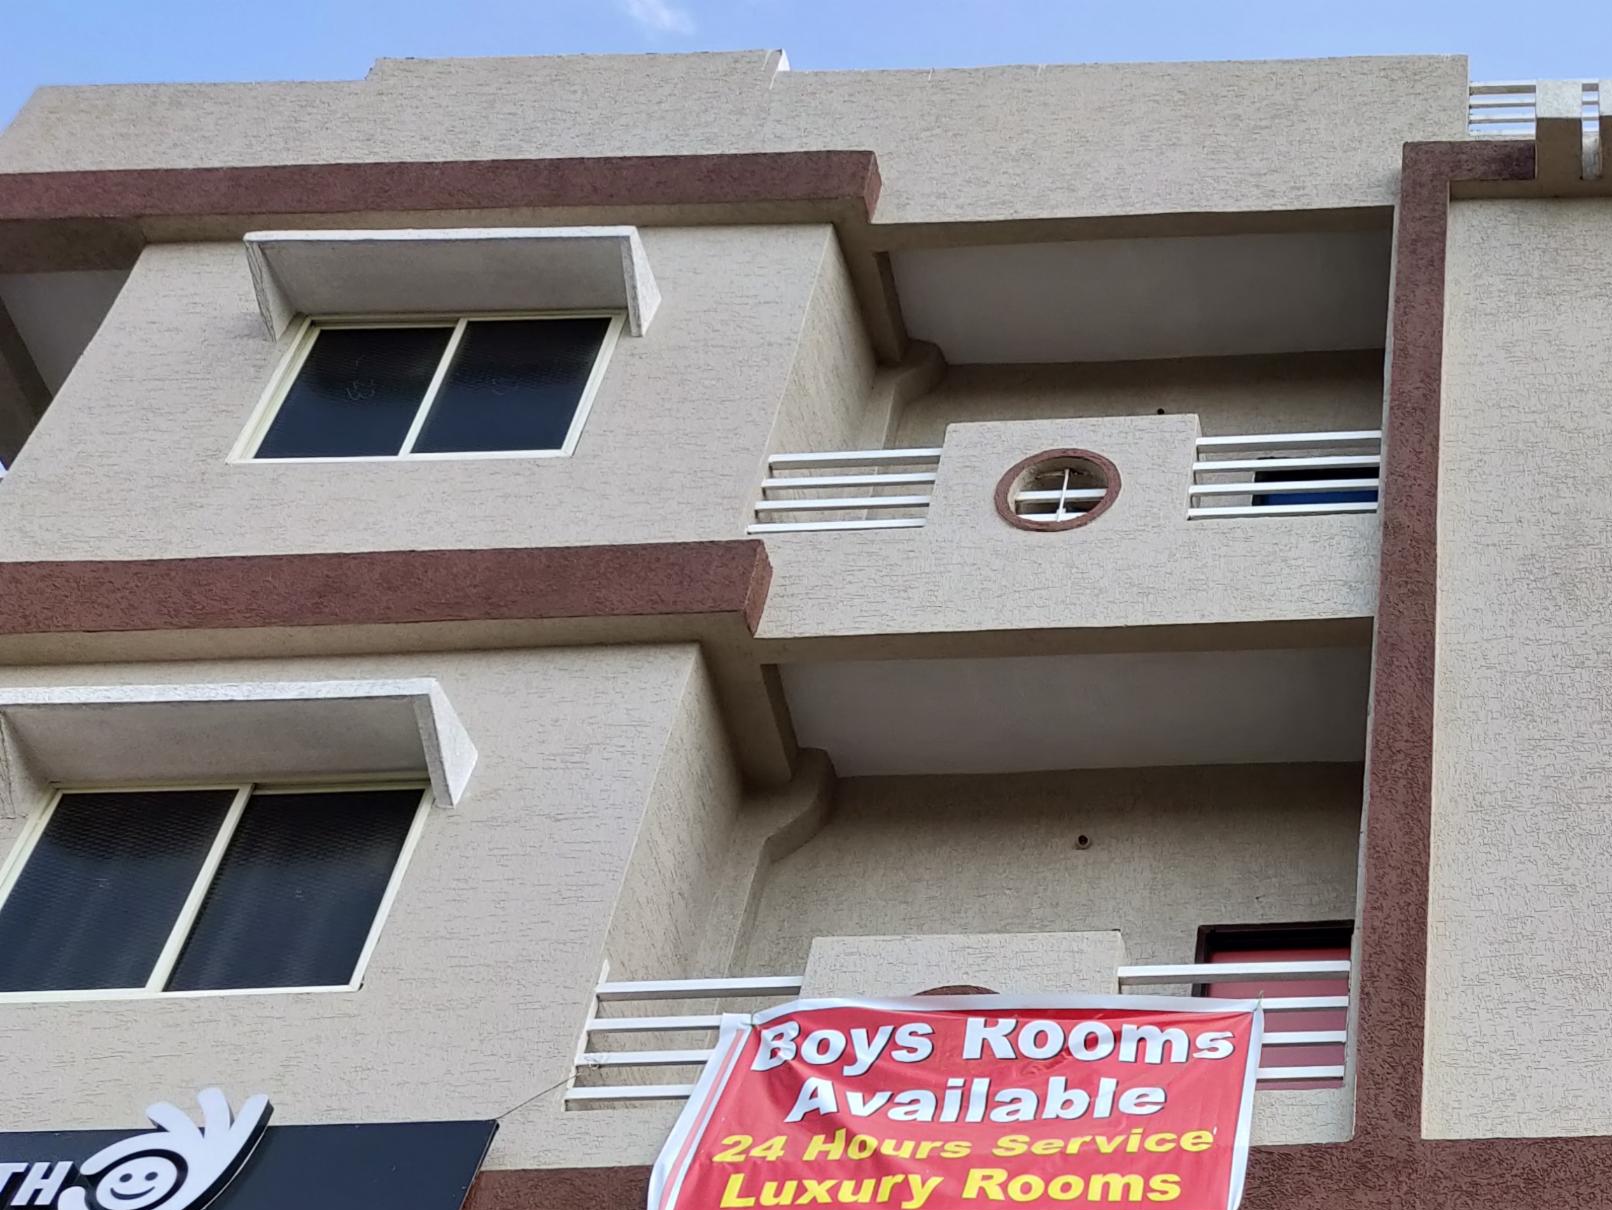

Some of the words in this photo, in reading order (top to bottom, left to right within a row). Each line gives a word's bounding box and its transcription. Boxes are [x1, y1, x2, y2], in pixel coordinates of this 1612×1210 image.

[750, 1018, 934, 1077] Boys
[963, 1018, 1234, 1064] Rooms
[784, 1076, 1167, 1123] Available
[711, 1134, 785, 1162] 24
[802, 1127, 970, 1162] Hours
[992, 1127, 1214, 1158] Service
[719, 1172, 944, 1210] Luxury
[961, 1168, 1182, 1203] Rooms
